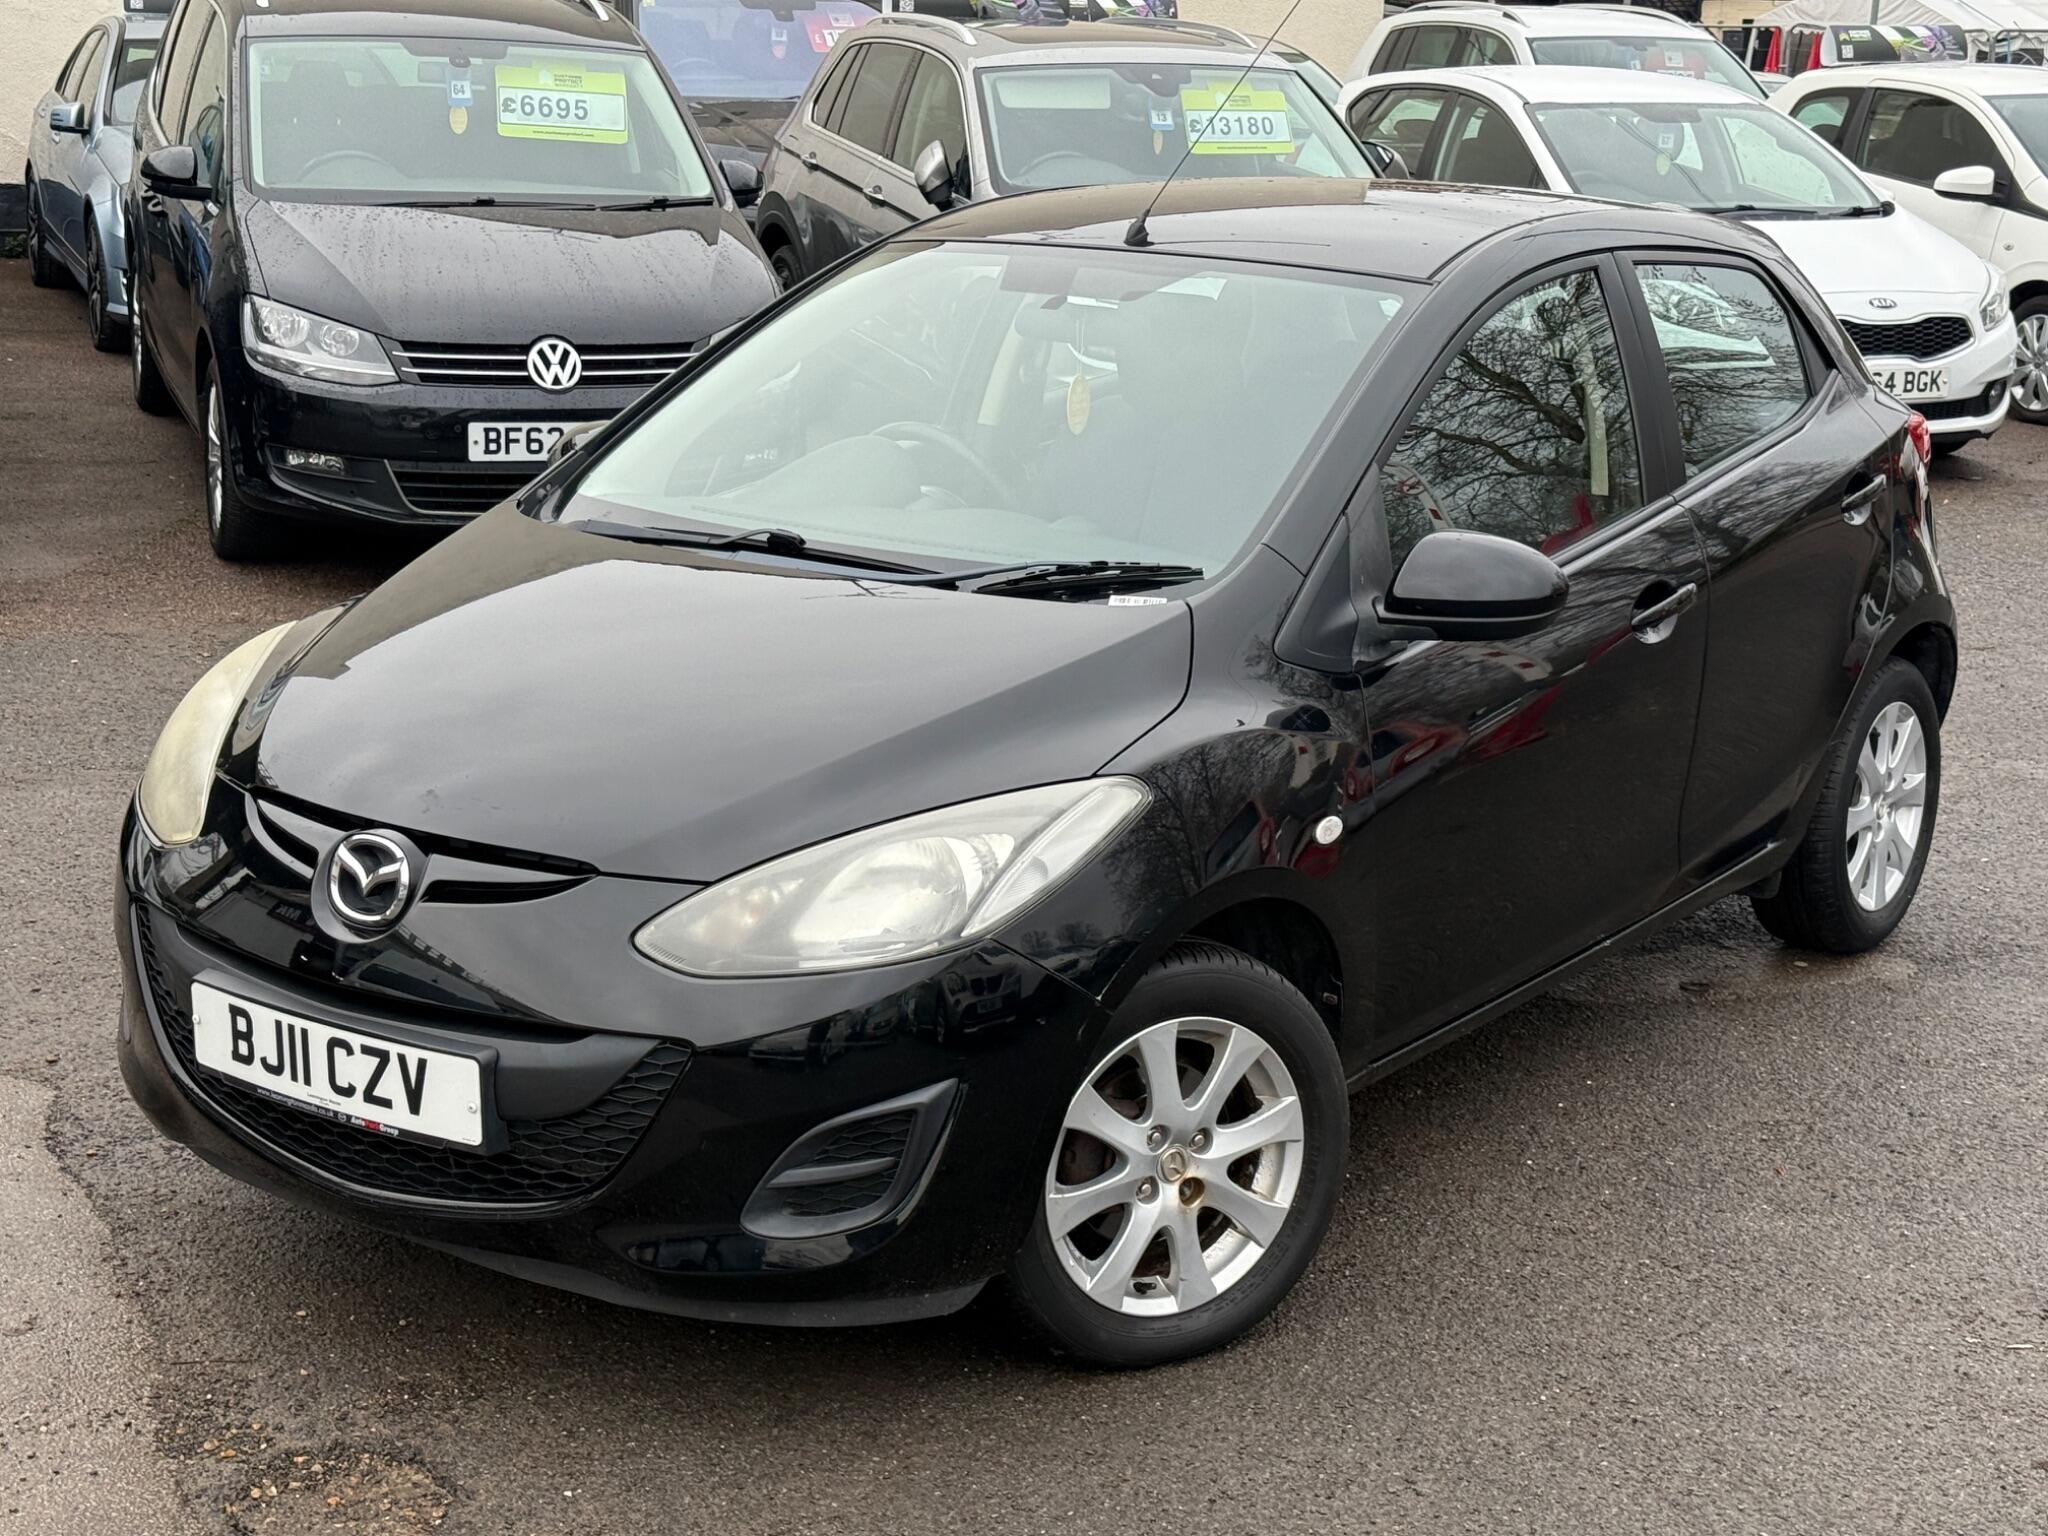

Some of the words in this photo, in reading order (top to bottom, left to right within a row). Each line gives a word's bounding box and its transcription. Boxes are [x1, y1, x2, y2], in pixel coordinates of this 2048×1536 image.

[453, 83, 466, 95] 64
[501, 95, 588, 120] £6695
[1156, 112, 1168, 122] 13
[1869, 298, 1897, 309] KIA
[1903, 370, 1943, 393] BGK
[228, 1002, 312, 1088] BJ11
[326, 1036, 428, 1117] CZV
